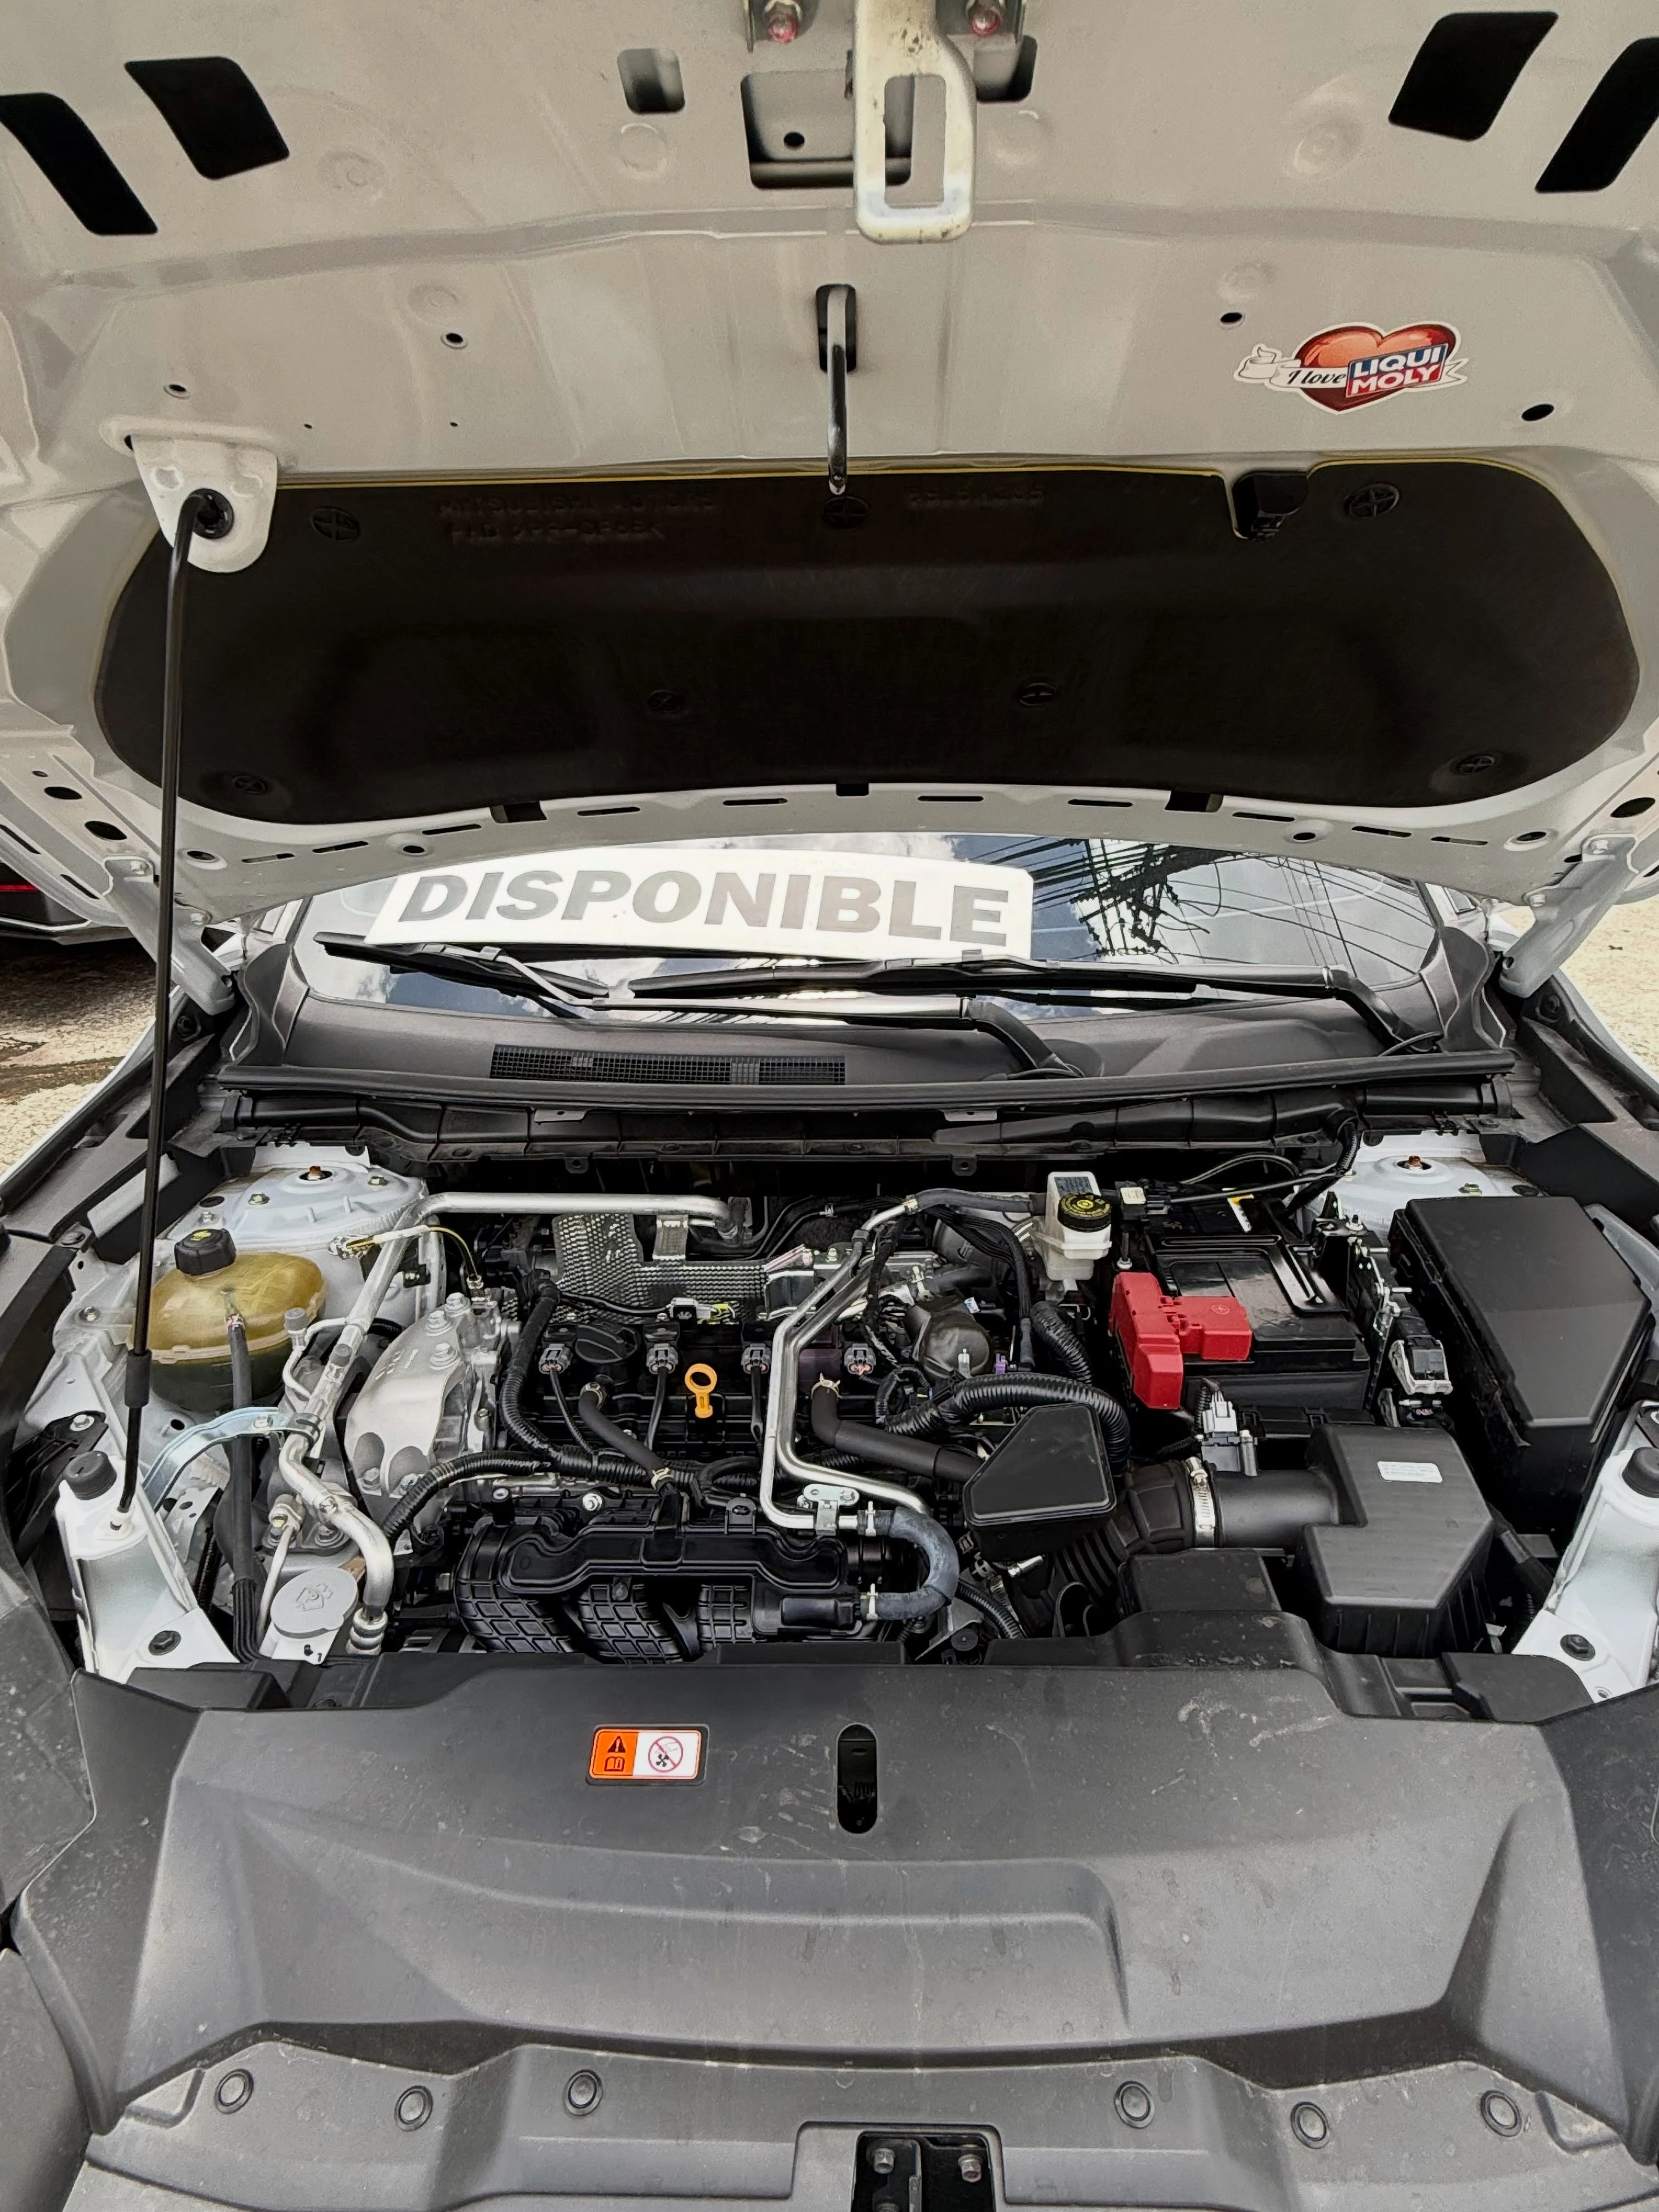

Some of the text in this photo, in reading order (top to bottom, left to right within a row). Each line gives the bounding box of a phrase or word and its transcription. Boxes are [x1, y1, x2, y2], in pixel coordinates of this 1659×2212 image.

[1354, 347, 1442, 377] LIQUI
[1288, 370, 1346, 385] I love
[1351, 364, 1440, 394] MOLY
[397, 870, 1009, 946] DISPONIBLE
